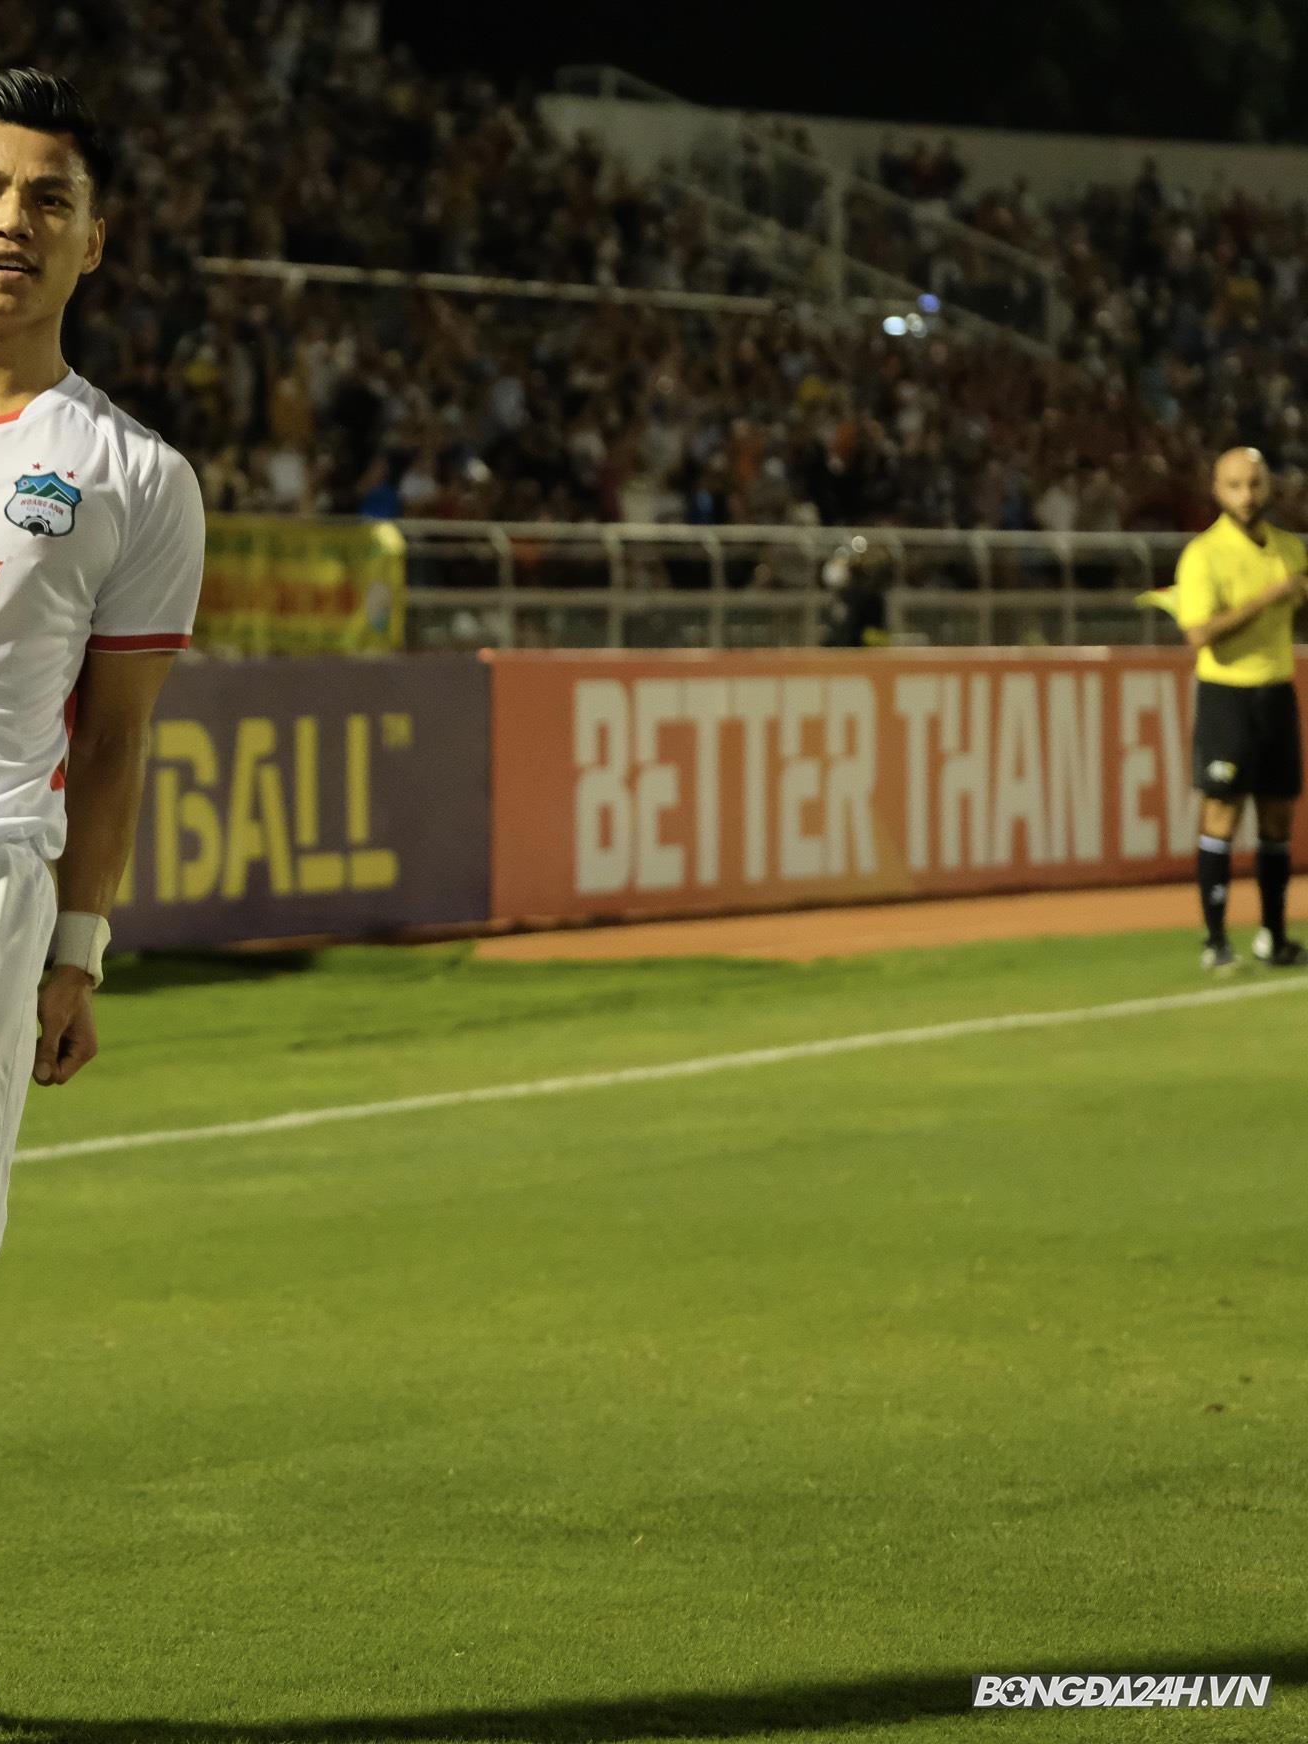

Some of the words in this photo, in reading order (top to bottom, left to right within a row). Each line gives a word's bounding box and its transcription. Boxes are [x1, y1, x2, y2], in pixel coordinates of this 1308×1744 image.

[116, 714, 398, 905] BALL
[574, 676, 879, 893] BETTER
[896, 671, 1102, 871] THAN
[1118, 669, 1260, 858] EV
